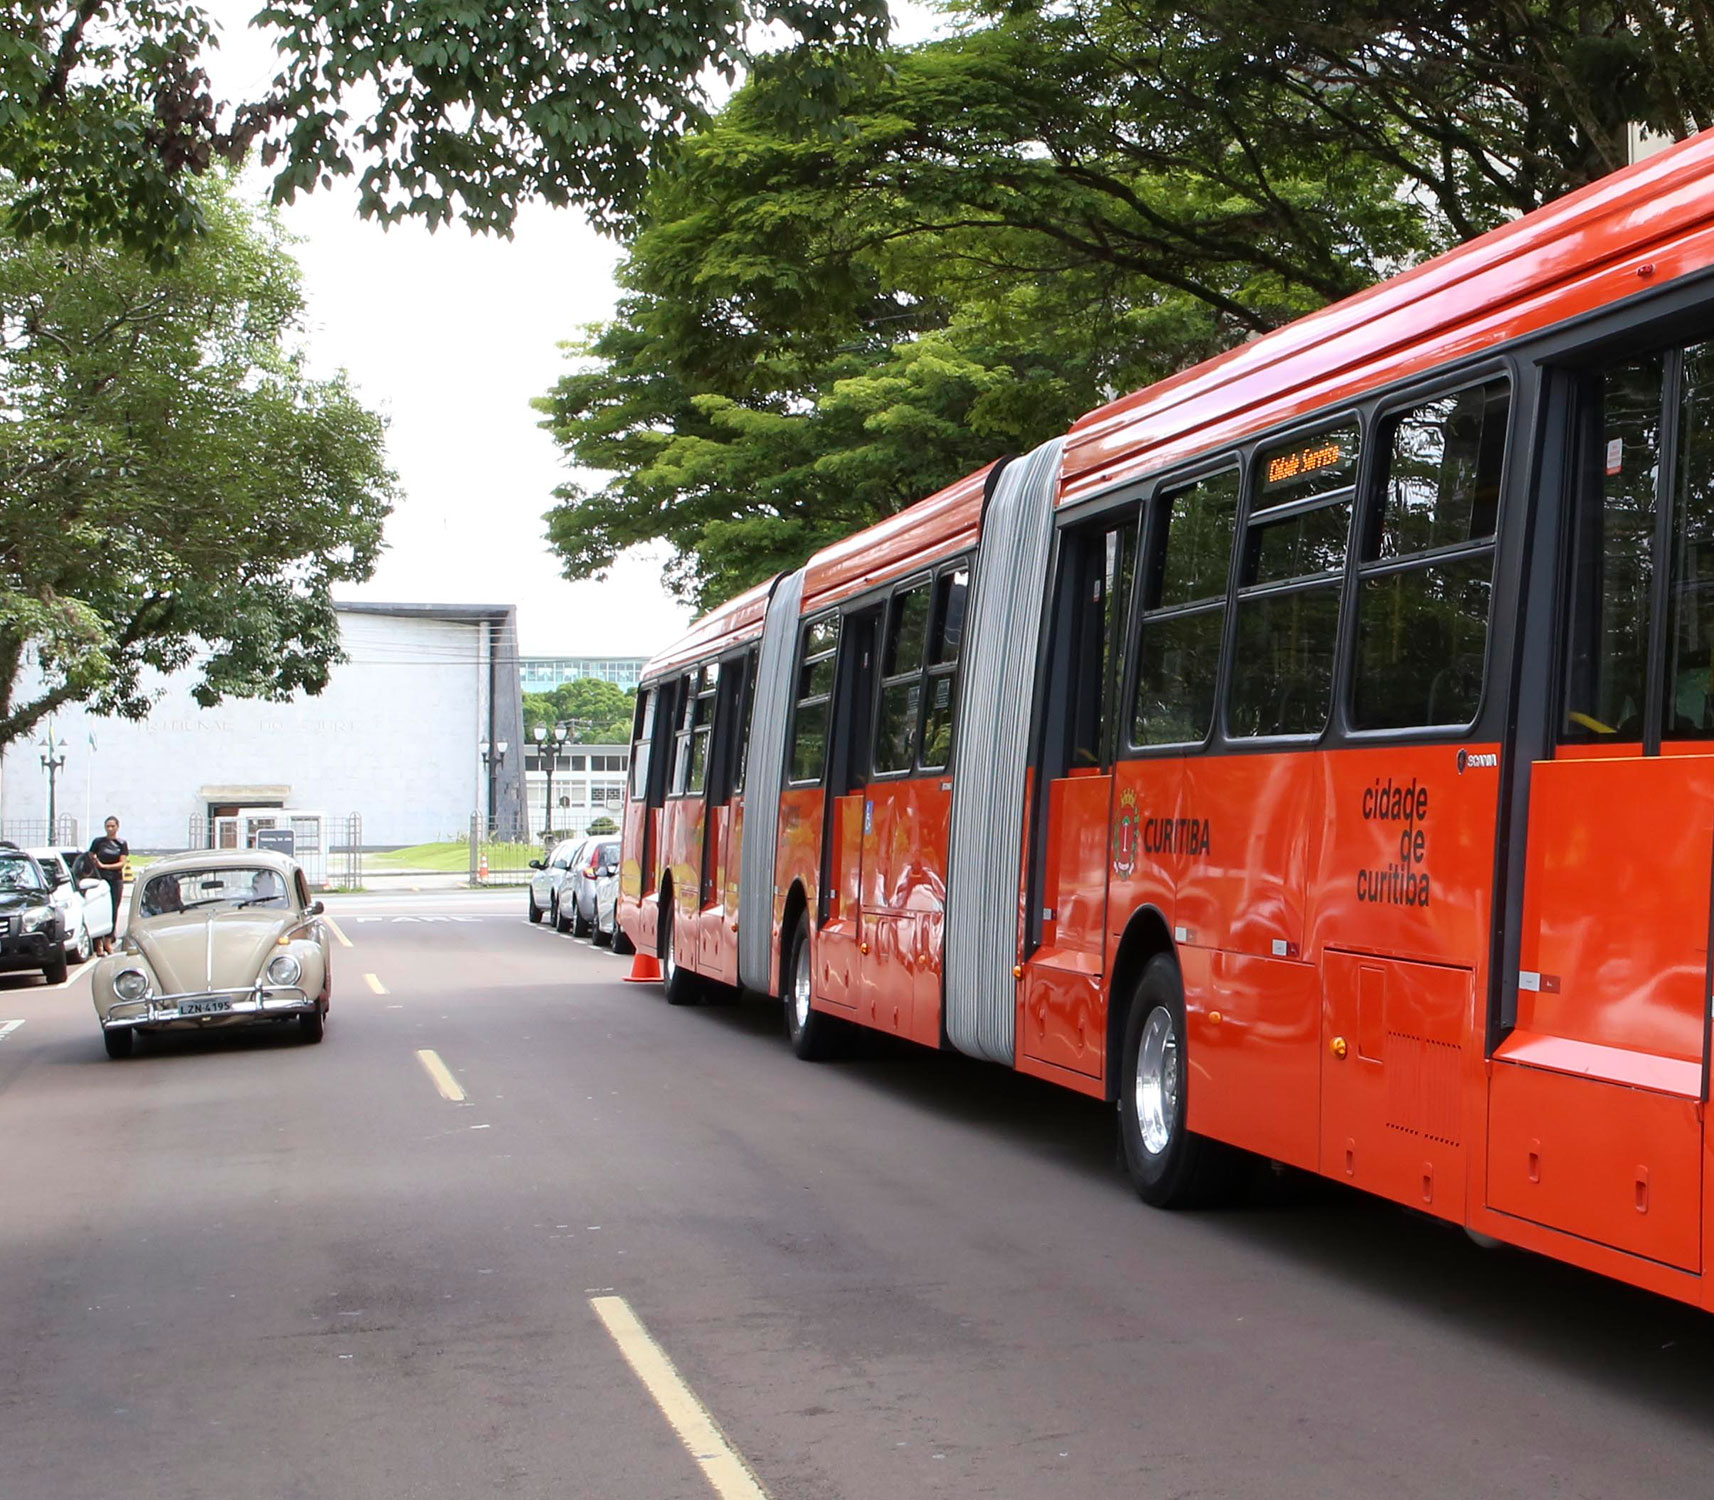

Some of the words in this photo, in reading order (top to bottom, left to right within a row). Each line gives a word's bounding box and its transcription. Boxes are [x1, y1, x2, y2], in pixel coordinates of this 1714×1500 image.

[1362, 777, 1428, 822] cidade
[1144, 817, 1210, 856] CURITIBA
[1401, 828, 1426, 864] de
[1357, 862, 1430, 907] curitiba
